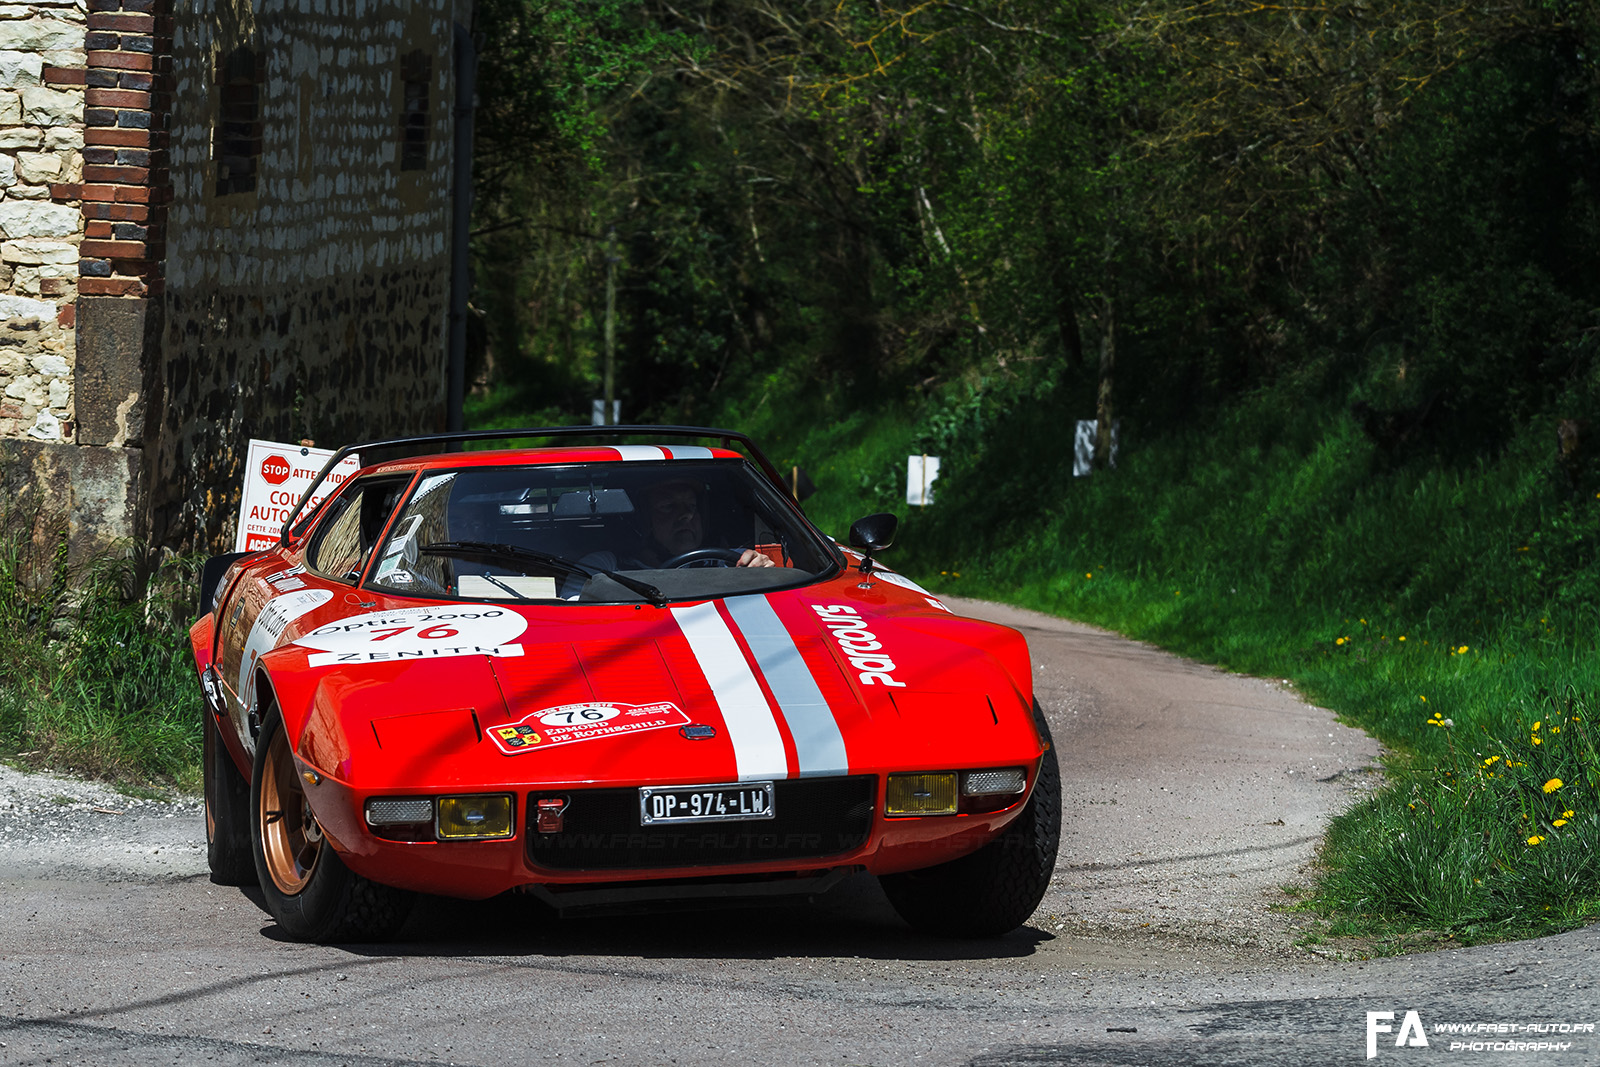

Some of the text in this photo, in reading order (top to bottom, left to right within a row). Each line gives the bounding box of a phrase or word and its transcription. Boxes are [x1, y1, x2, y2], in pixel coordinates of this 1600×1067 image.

[263, 463, 347, 484] STOP ATTETIO
[247, 524, 266, 533] CETTE
[312, 616, 408, 636] Optic
[418, 610, 505, 622] 2000
[369, 623, 460, 642] 76
[337, 646, 501, 662] ZENITH
[554, 708, 604, 723] 76
[543, 721, 609, 736] EDMOND
[549, 719, 667, 743] DE ROTHSCHILD
